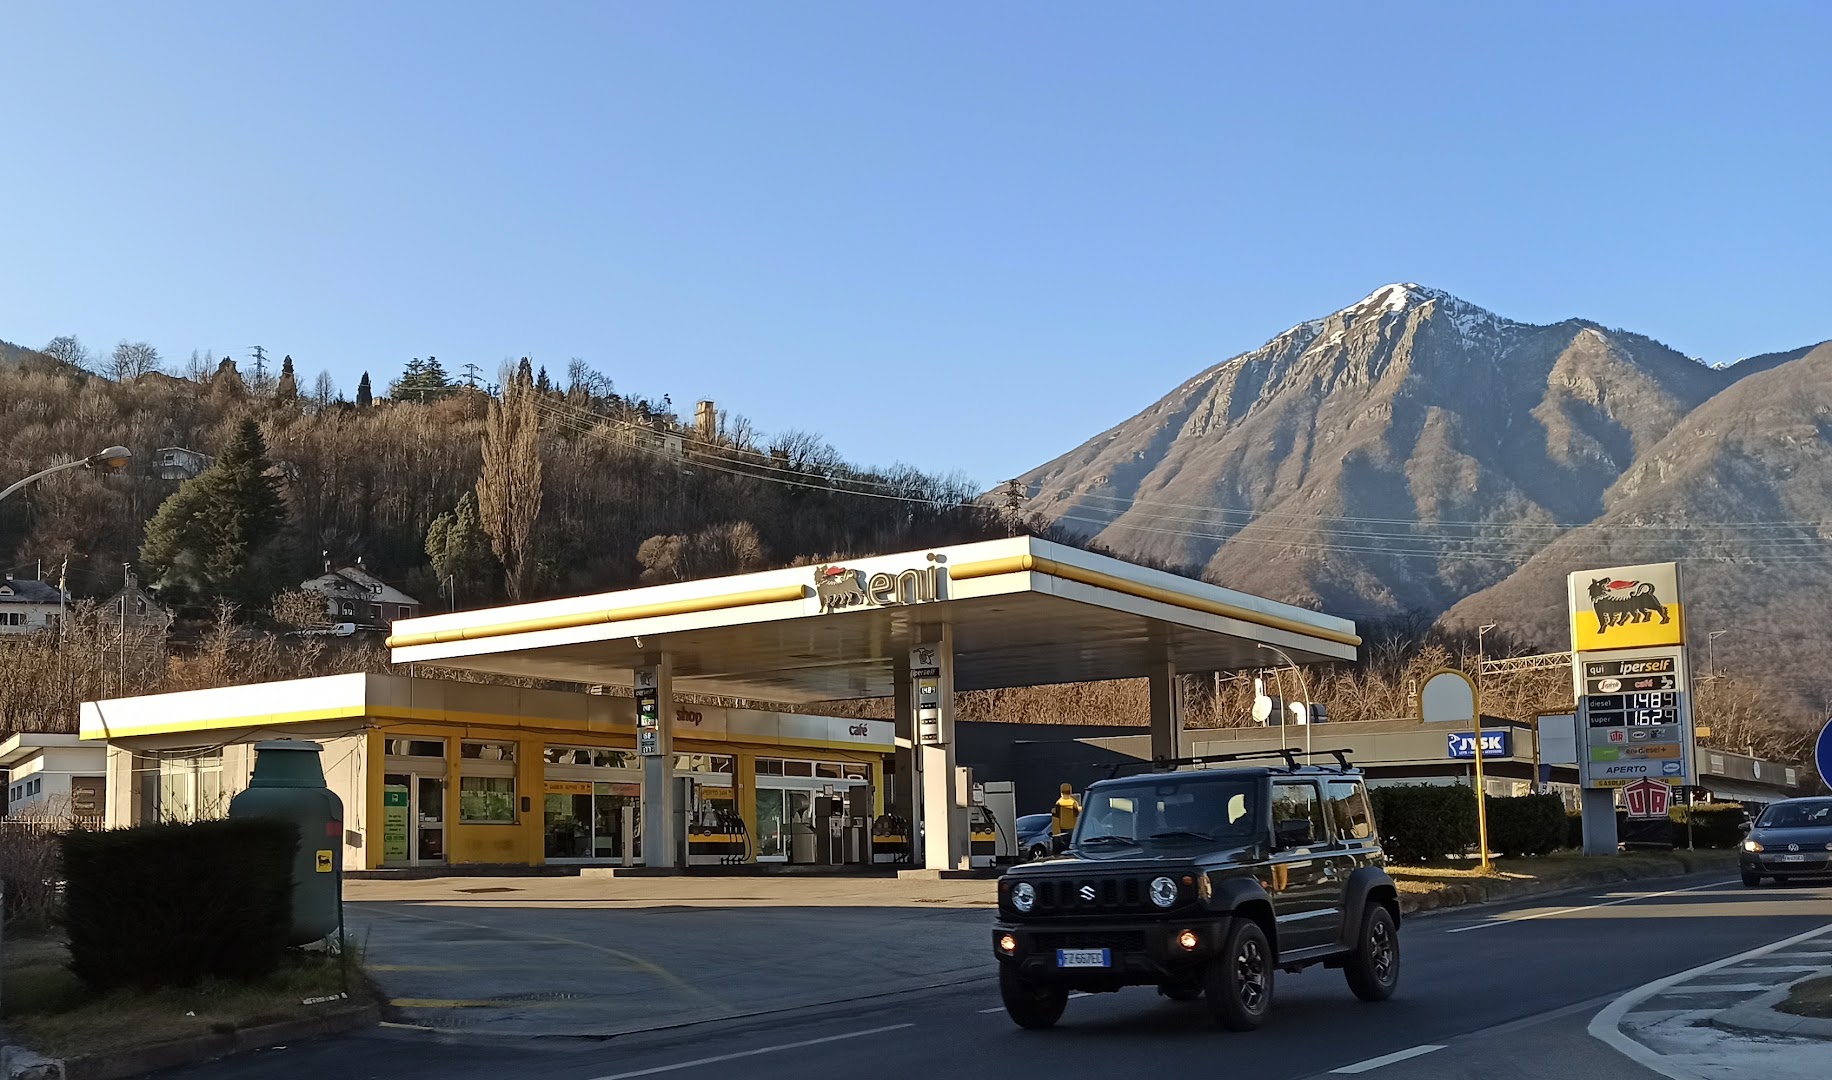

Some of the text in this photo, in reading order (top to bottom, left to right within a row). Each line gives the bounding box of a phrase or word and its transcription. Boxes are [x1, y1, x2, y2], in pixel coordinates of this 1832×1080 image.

[867, 552, 938, 606] eni
[1590, 659, 1670, 676] qui iperself
[676, 707, 702, 726] shop
[849, 723, 868, 736] café
[1459, 736, 1502, 750] JYSK
[1606, 765, 1647, 774] APERTO
